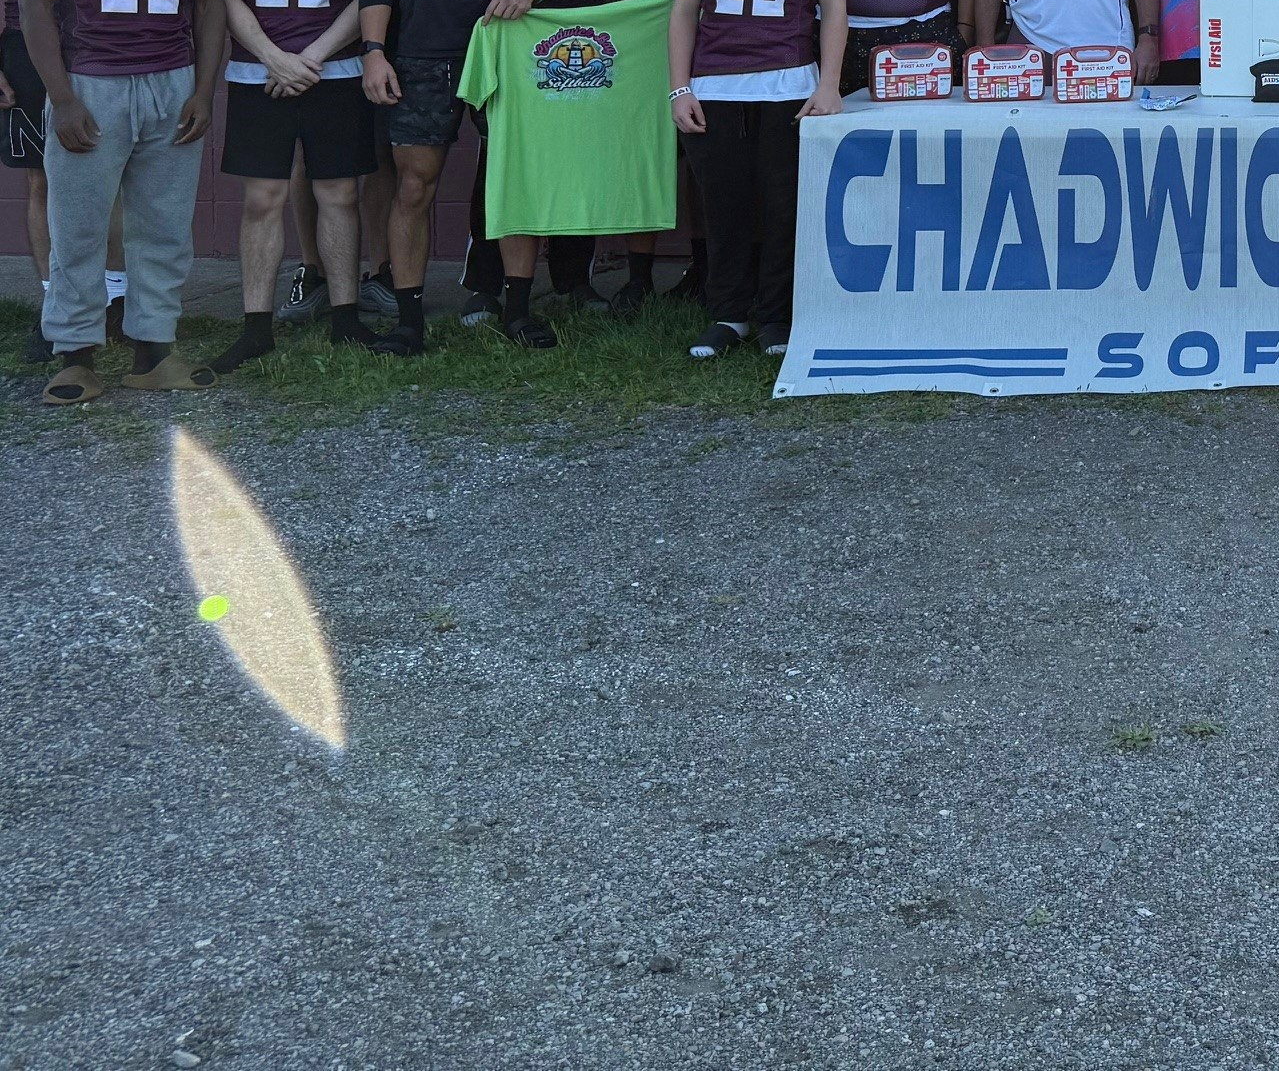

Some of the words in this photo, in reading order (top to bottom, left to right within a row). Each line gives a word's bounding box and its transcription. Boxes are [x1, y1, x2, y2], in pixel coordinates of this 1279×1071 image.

[1208, 18, 1222, 39] Aid
[1208, 40, 1222, 68] First
[544, 75, 607, 91] Softball
